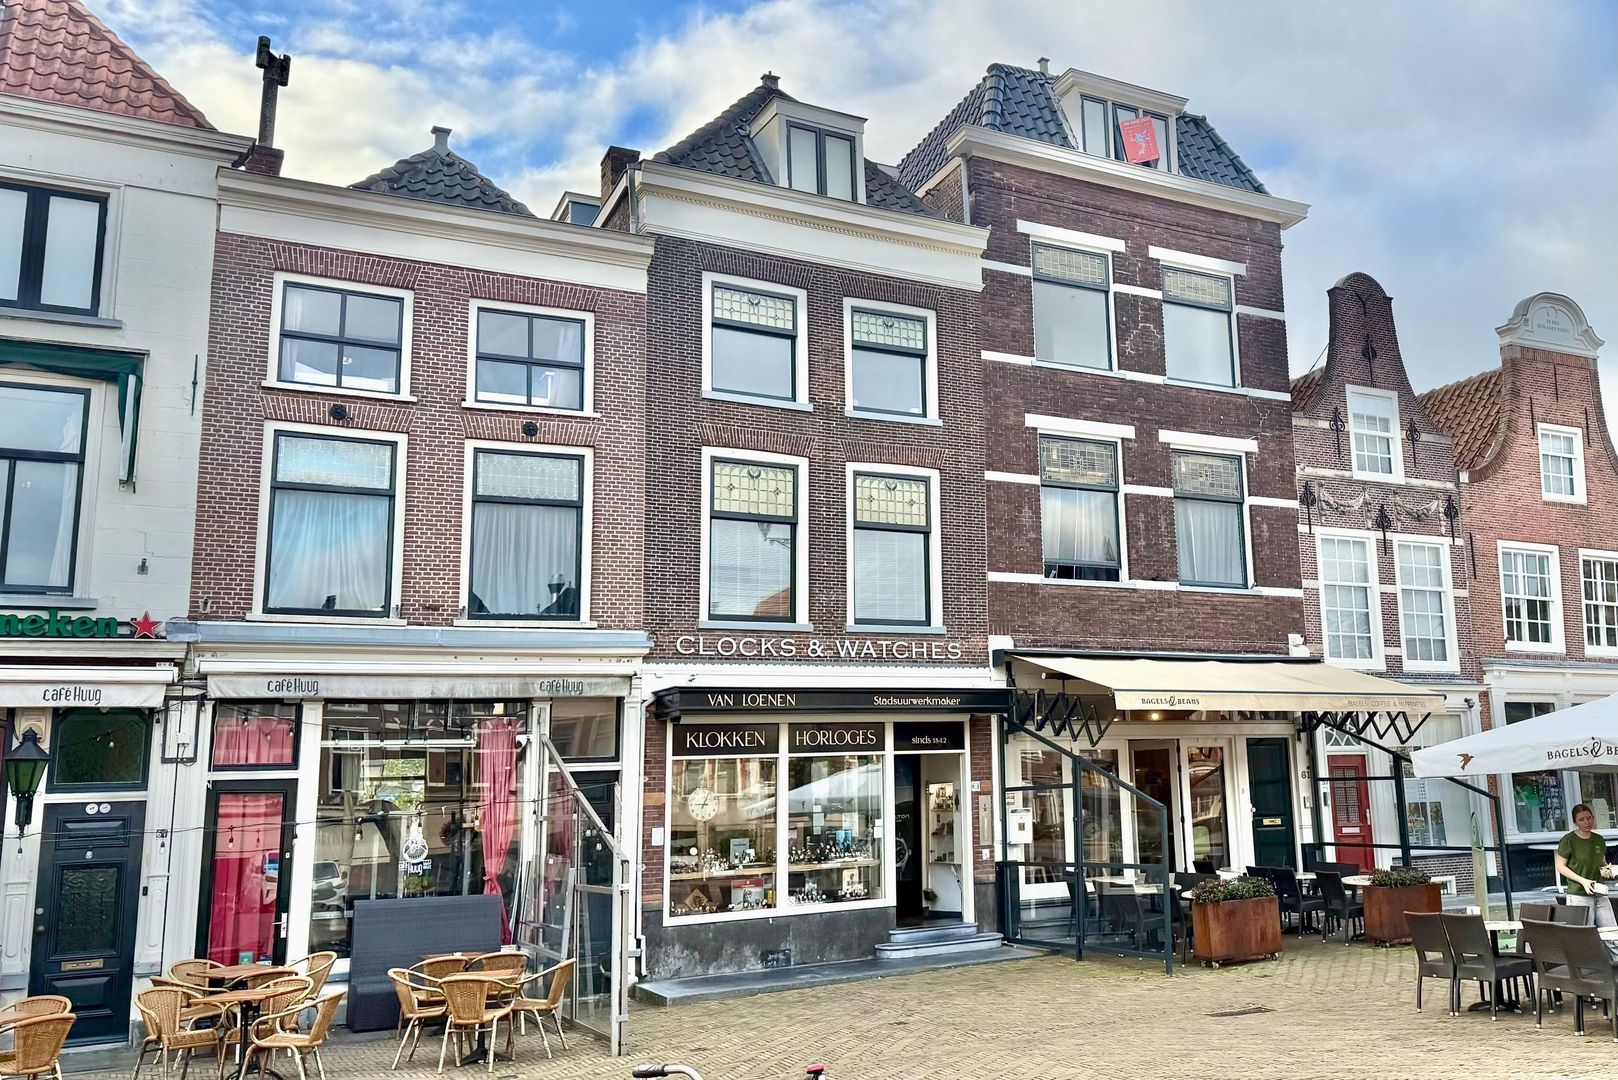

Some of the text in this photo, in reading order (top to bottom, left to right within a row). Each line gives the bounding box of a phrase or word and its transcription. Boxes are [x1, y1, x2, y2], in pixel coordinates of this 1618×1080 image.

[676, 635, 962, 660] CLOCKS & WATCHES
[267, 678, 319, 696] café Huug
[540, 678, 584, 695] café Huug
[42, 686, 102, 706] café Huug
[707, 693, 796, 707] VAN LOENEN
[873, 695, 961, 706] Stadsuurwerkmaker
[1168, 694, 1177, 707] &
[686, 730, 766, 748] KLOKKEN
[796, 729, 877, 746] HORLOGES
[911, 735, 948, 745] sinds 1842
[1547, 746, 1589, 760] BAGELS
[1590, 737, 1605, 758] &
